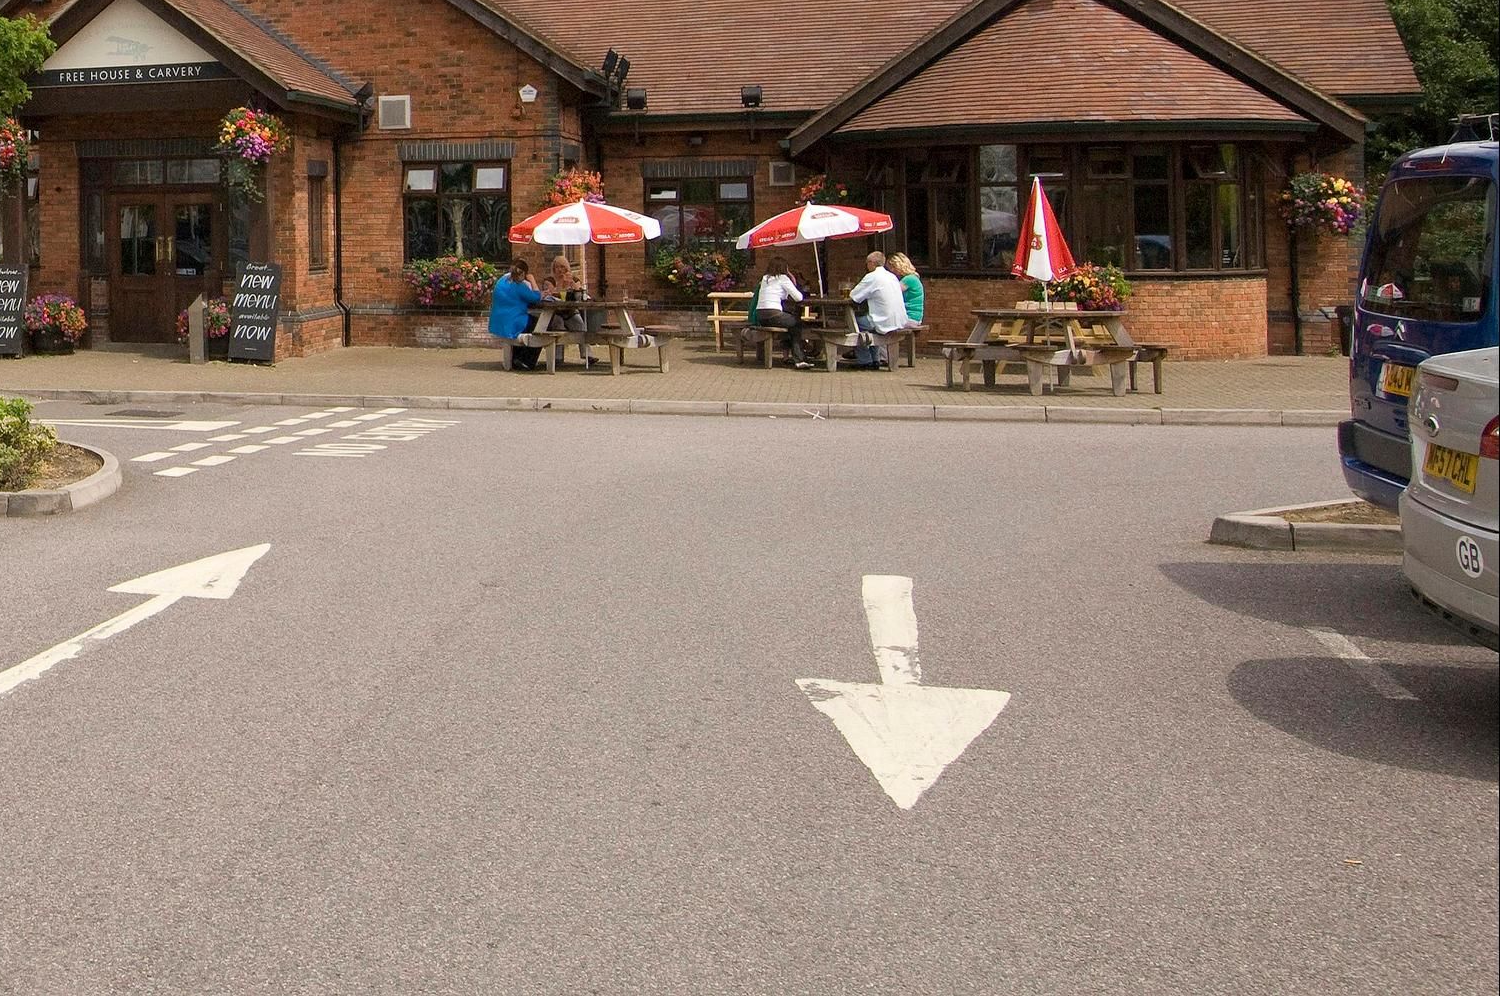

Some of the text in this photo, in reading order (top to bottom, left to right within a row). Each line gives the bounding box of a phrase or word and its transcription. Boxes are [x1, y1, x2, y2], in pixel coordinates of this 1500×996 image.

[59, 66, 202, 82] FREE HOUSE & CARVERY
[240, 274, 275, 290] new
[233, 292, 278, 309] menu
[238, 313, 270, 321] available
[233, 324, 272, 341] now
[292, 417, 462, 458] NO ENTRY
[1459, 540, 1480, 573] GB
